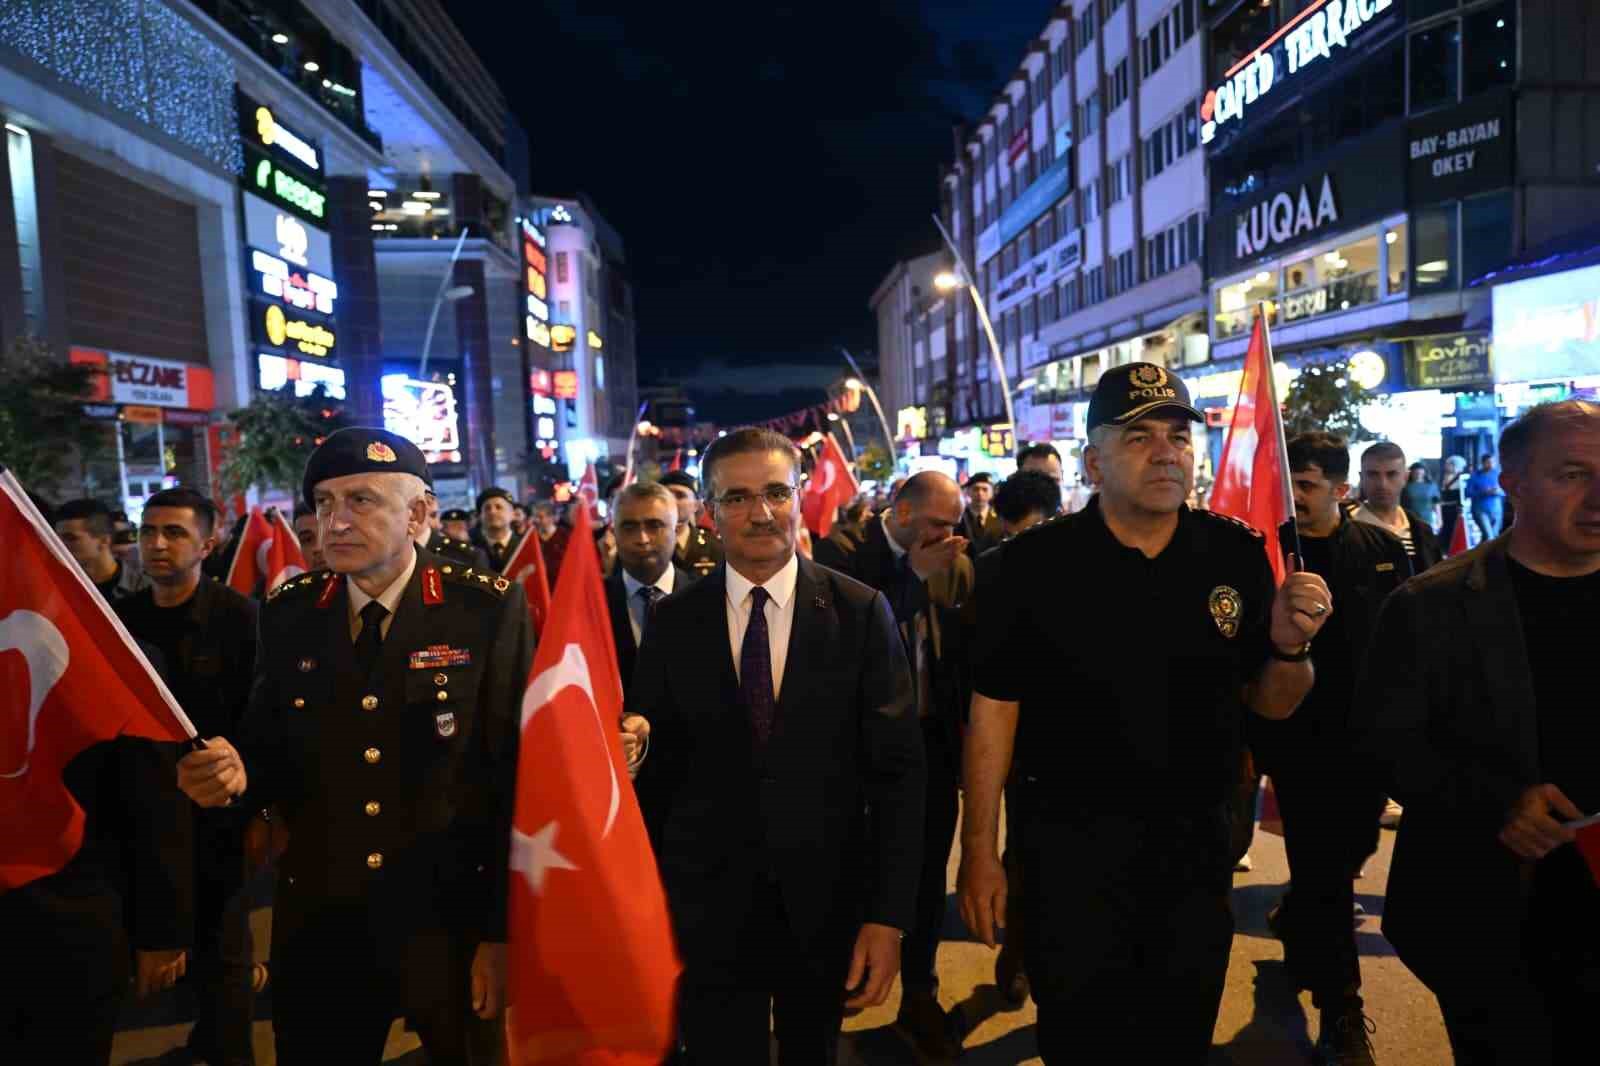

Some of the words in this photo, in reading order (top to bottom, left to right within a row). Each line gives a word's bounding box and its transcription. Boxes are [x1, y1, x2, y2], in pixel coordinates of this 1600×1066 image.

[1284, 0, 1393, 74] TERRAC
[1410, 118, 1500, 160] BAY-BAYAN
[1431, 150, 1475, 177] OKEY
[1236, 172, 1338, 259] KUQAA
